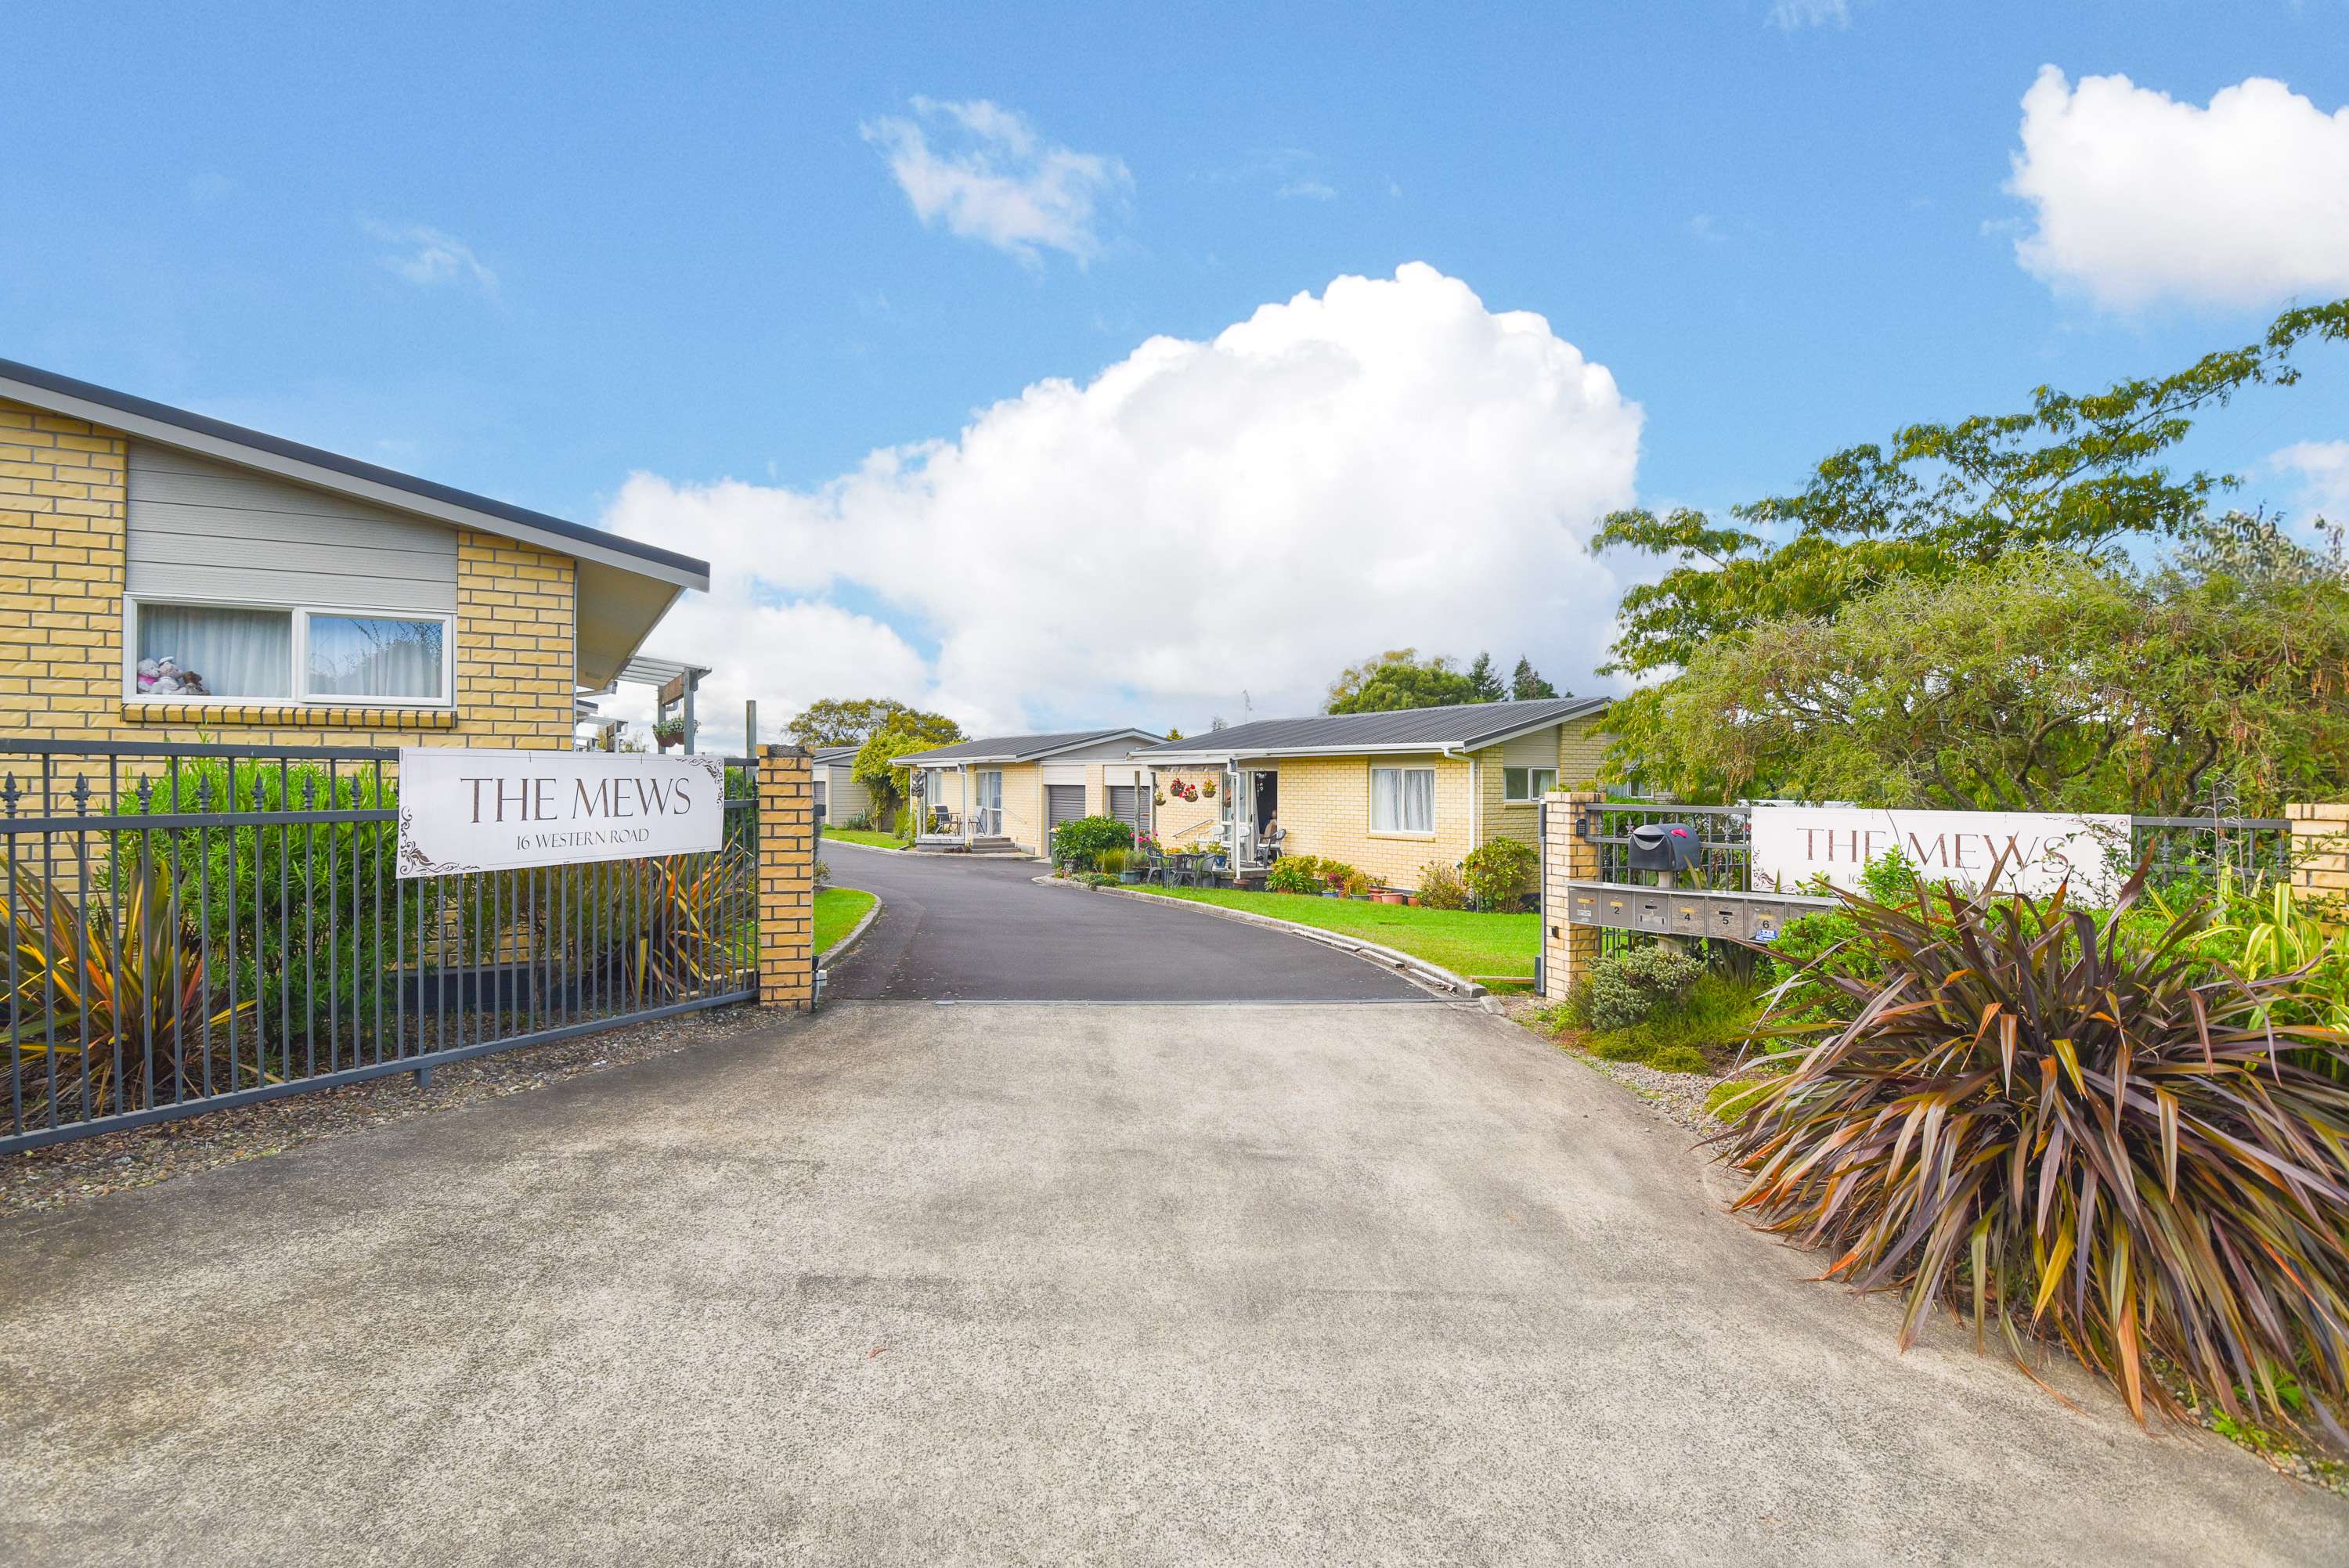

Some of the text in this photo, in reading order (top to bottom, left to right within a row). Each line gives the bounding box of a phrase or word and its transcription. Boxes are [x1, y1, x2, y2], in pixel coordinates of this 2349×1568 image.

[460, 777, 691, 823] THE MEWS
[517, 827, 649, 850] 16 WESTERN ROAD
[1796, 827, 2069, 874] THE MEWS
[1614, 907, 1620, 915] 2
[1763, 920, 1770, 928] 6
